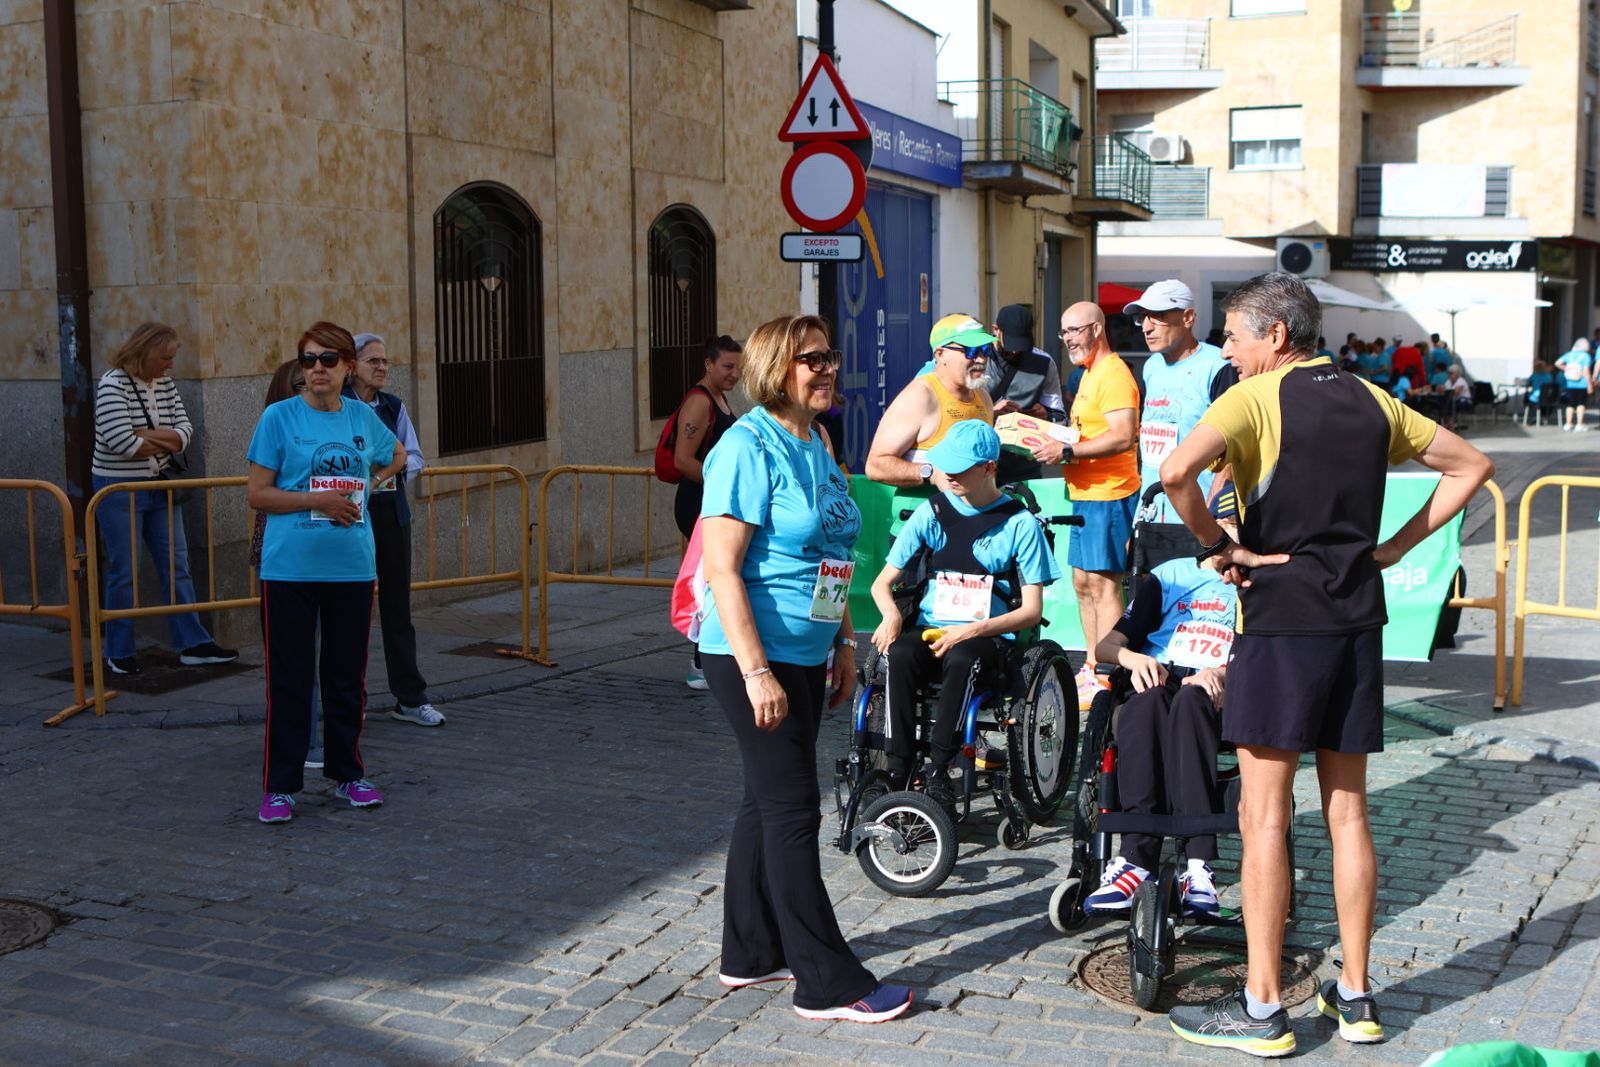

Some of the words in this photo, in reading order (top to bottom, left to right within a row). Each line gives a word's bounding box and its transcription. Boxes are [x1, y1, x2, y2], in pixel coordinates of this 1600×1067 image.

[804, 239, 839, 247] EXCEPTO
[803, 249, 840, 257] GARAJES
[1388, 244, 1407, 267] &
[1145, 440, 1166, 455] 177
[311, 478, 364, 491] bedunia
[1176, 623, 1234, 643] beduni
[1189, 639, 1223, 658] 176
